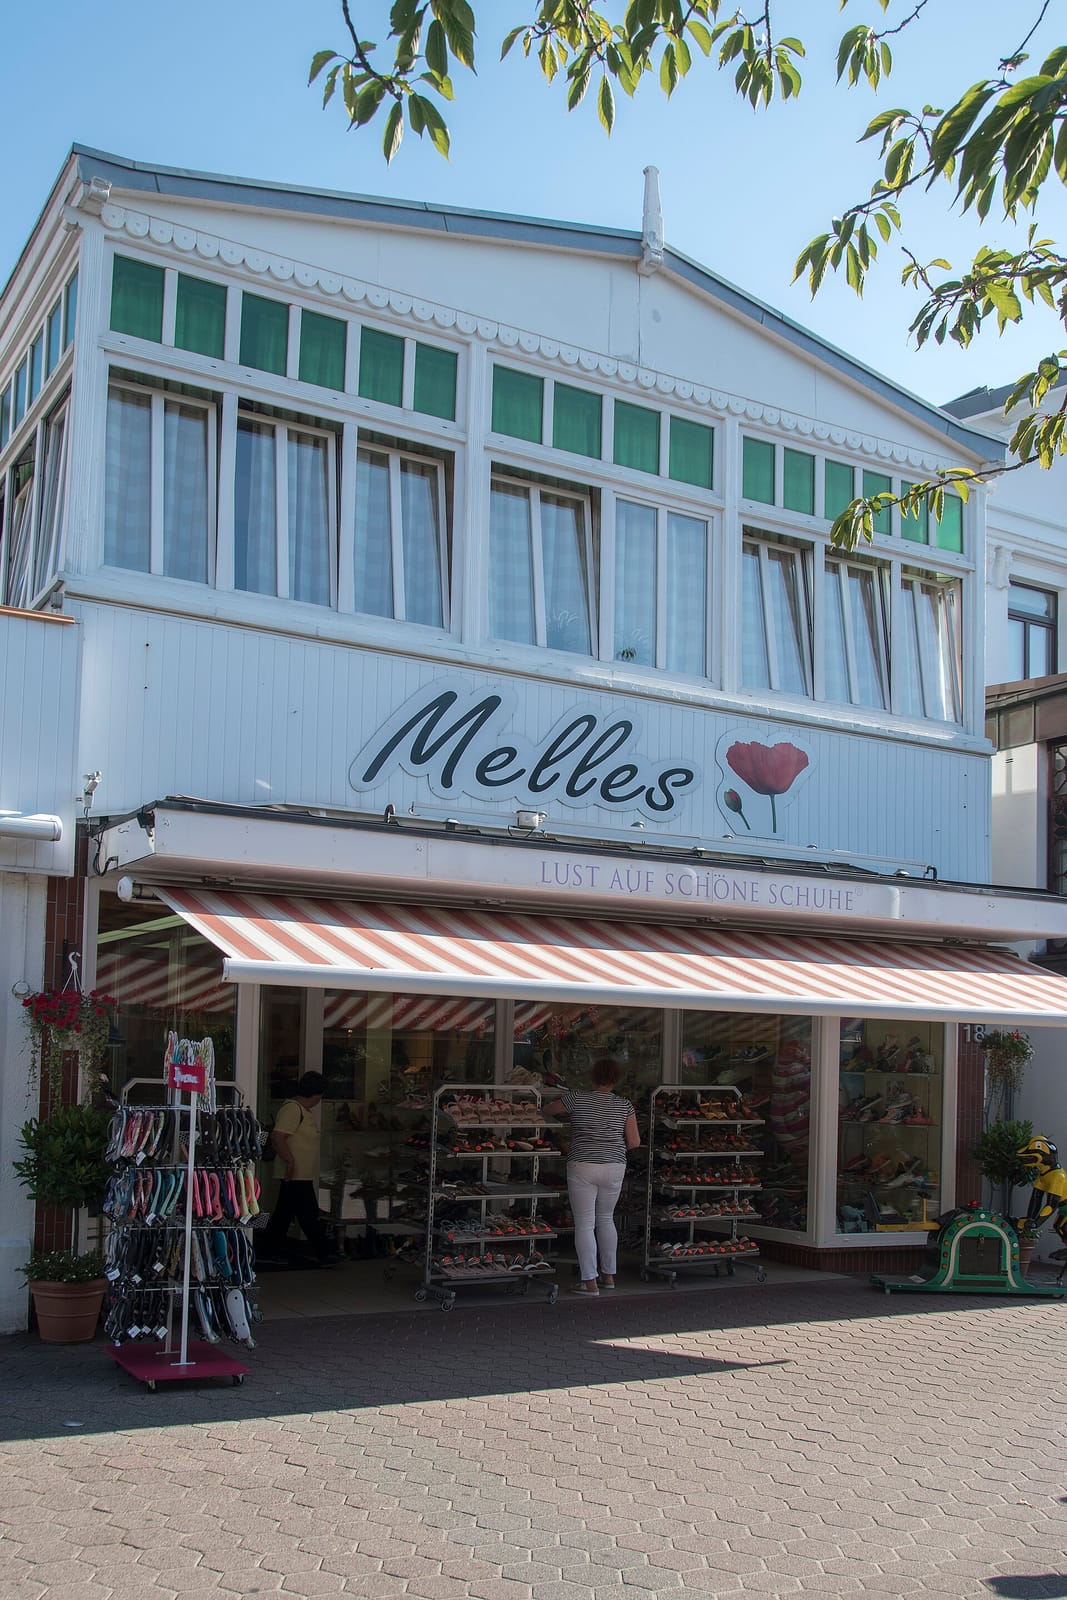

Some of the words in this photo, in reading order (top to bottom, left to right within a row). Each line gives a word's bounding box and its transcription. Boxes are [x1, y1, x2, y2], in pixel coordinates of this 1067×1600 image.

[362, 690, 694, 812] Melles
[540, 861, 600, 888] LUST
[609, 868, 655, 893] AUF
[665, 873, 759, 903] SCHÖNE
[963, 1024, 985, 1042] 18
